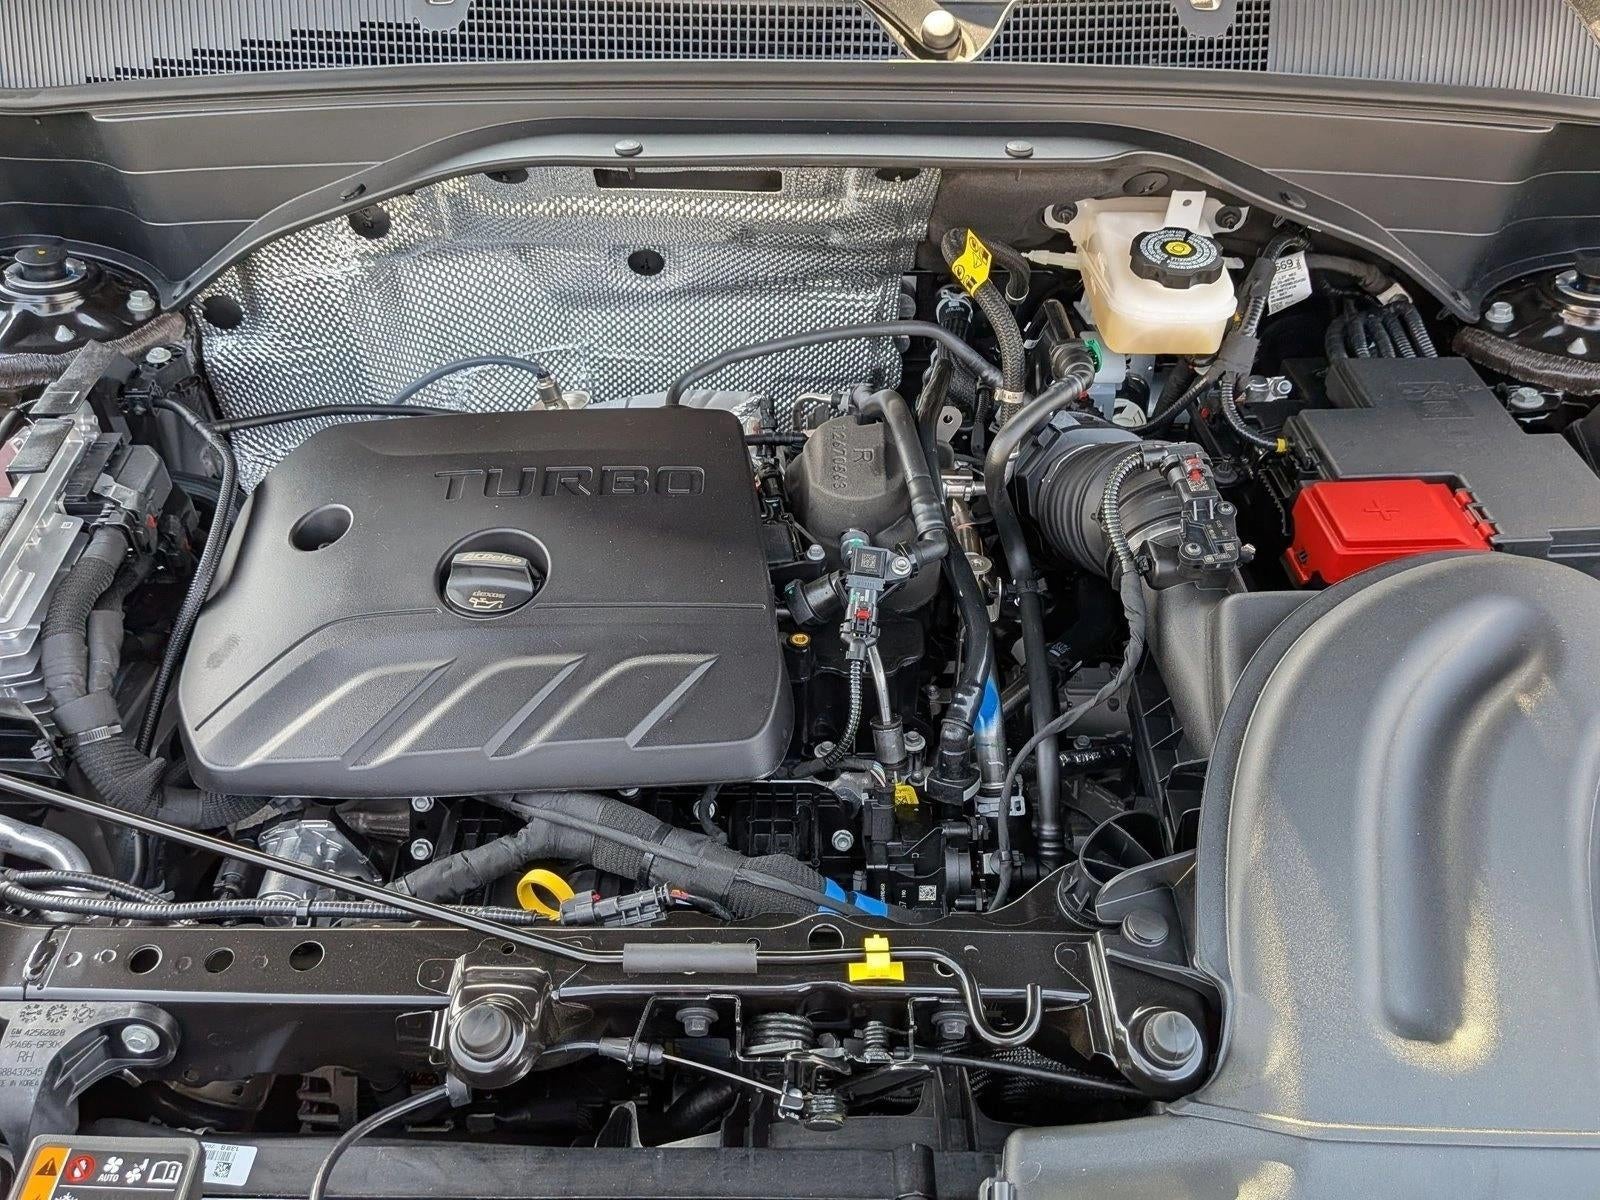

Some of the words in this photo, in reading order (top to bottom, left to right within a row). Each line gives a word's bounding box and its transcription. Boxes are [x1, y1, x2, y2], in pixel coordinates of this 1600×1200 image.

[853, 448, 875, 463] R
[434, 465, 706, 500] TURBO
[16, 1050, 35, 1063] RH
[97, 1173, 120, 1182] AUTO
